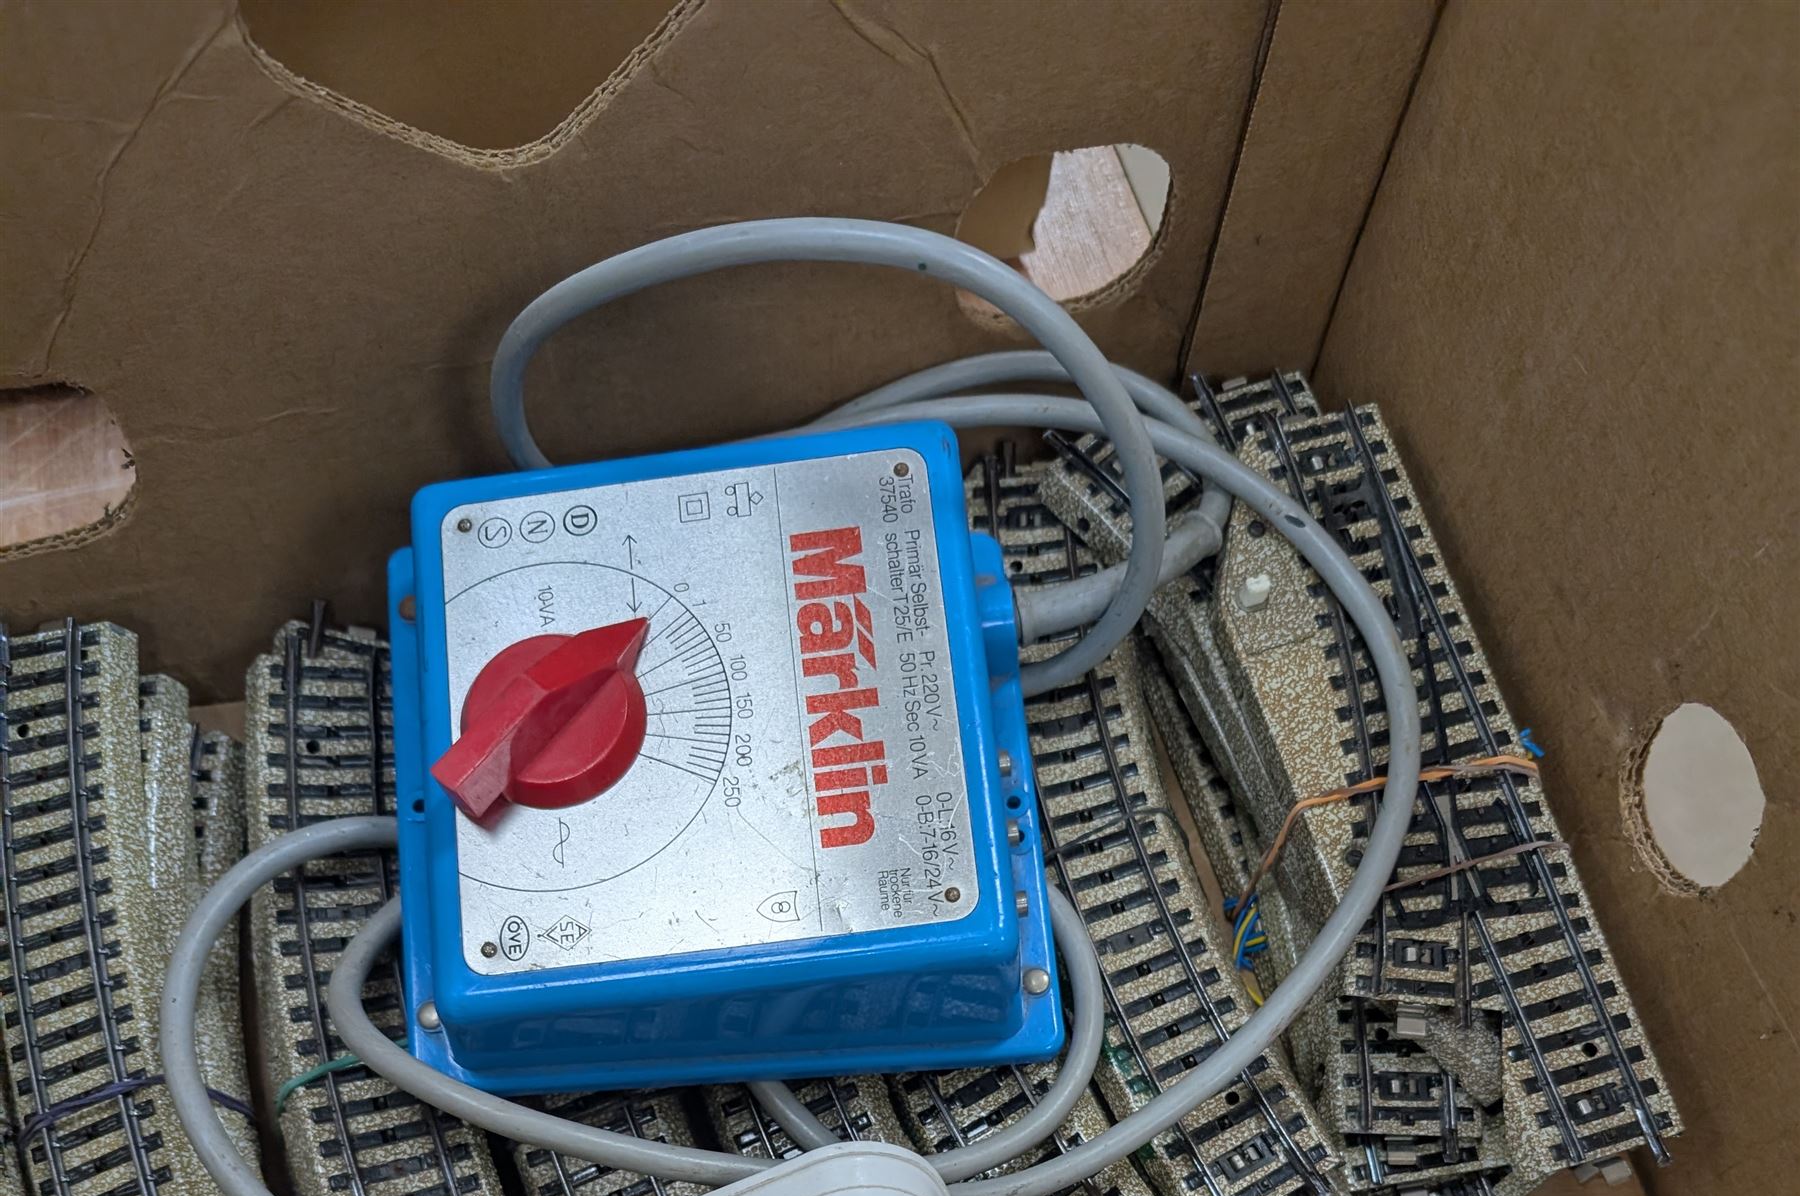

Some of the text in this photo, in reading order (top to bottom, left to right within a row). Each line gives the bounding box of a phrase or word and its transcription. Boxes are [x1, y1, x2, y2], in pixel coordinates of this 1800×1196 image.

[879, 476, 898, 524] 37540
[899, 474, 916, 514] Trafo
[885, 532, 905, 593] schalter
[904, 529, 924, 581] Primär
[673, 582, 690, 593] 0
[911, 583, 931, 637] Selbst-
[714, 622, 732, 643] 50
[730, 654, 748, 682] 100
[900, 653, 917, 673] 50
[789, 526, 888, 849] Märklin
[902, 676, 919, 698] Hz
[736, 692, 754, 720] 150
[905, 701, 922, 732] Sec
[735, 733, 753, 767] 200
[722, 776, 742, 808] 250
[900, 867, 912, 887] Nur
[889, 869, 903, 918] trockene
